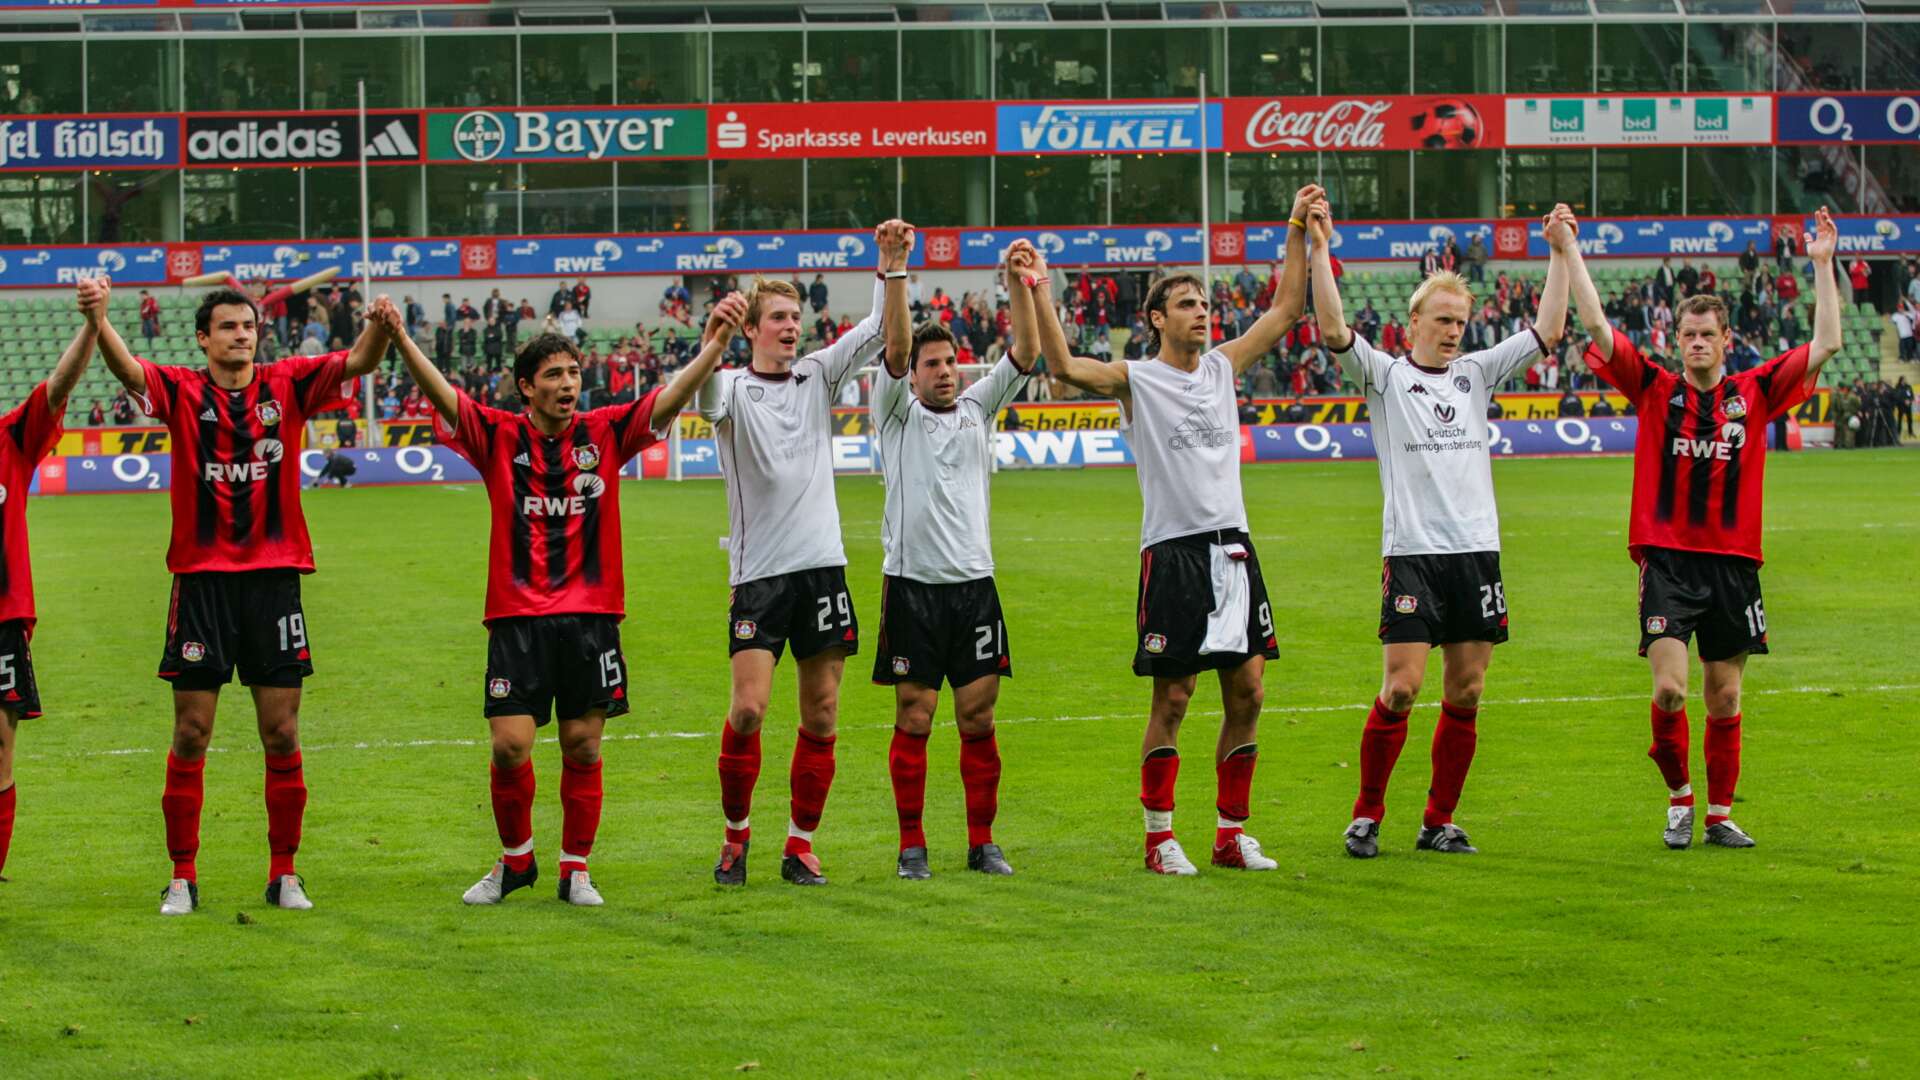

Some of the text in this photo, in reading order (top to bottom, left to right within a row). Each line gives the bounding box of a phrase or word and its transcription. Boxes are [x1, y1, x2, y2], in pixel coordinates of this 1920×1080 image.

[1020, 110, 1193, 149] VÖLKEL
[1246, 100, 1392, 148] Coca-Cola
[1809, 96, 1853, 140] O2
[1886, 96, 1920, 139] O
[54, 120, 164, 160] Kölsch
[188, 121, 342, 159] adidas
[459, 131, 500, 141] BAYER
[514, 111, 674, 160] Bayer
[757, 126, 987, 152] Sparkasse Leverkusen
[1105, 247, 1156, 262] RWE
[1390, 242, 1439, 257] RWE
[1577, 239, 1607, 253] WE
[1669, 237, 1718, 252] RWE
[1839, 235, 1885, 250] RWE
[235, 263, 285, 279] RWE
[352, 261, 404, 277] RWE
[554, 257, 606, 272] RWE
[676, 254, 727, 270] RWE
[798, 252, 849, 267] RWE
[997, 412, 1120, 431] sbeläge
[1427, 426, 1467, 438] Deutsche
[1555, 418, 1602, 452] O2
[989, 431, 1125, 464] RWE
[1295, 425, 1343, 458] O2
[1672, 437, 1732, 461] RWE
[112, 454, 160, 490] O2
[205, 461, 268, 482] RWE
[395, 447, 444, 481] O2
[523, 495, 586, 516] RWE
[817, 592, 850, 632] 29
[1480, 582, 1507, 618] 28
[277, 613, 306, 650] 19
[1258, 601, 1274, 638] 9
[1745, 598, 1766, 637] 16
[975, 619, 1002, 660] 21
[600, 649, 622, 687] 15
